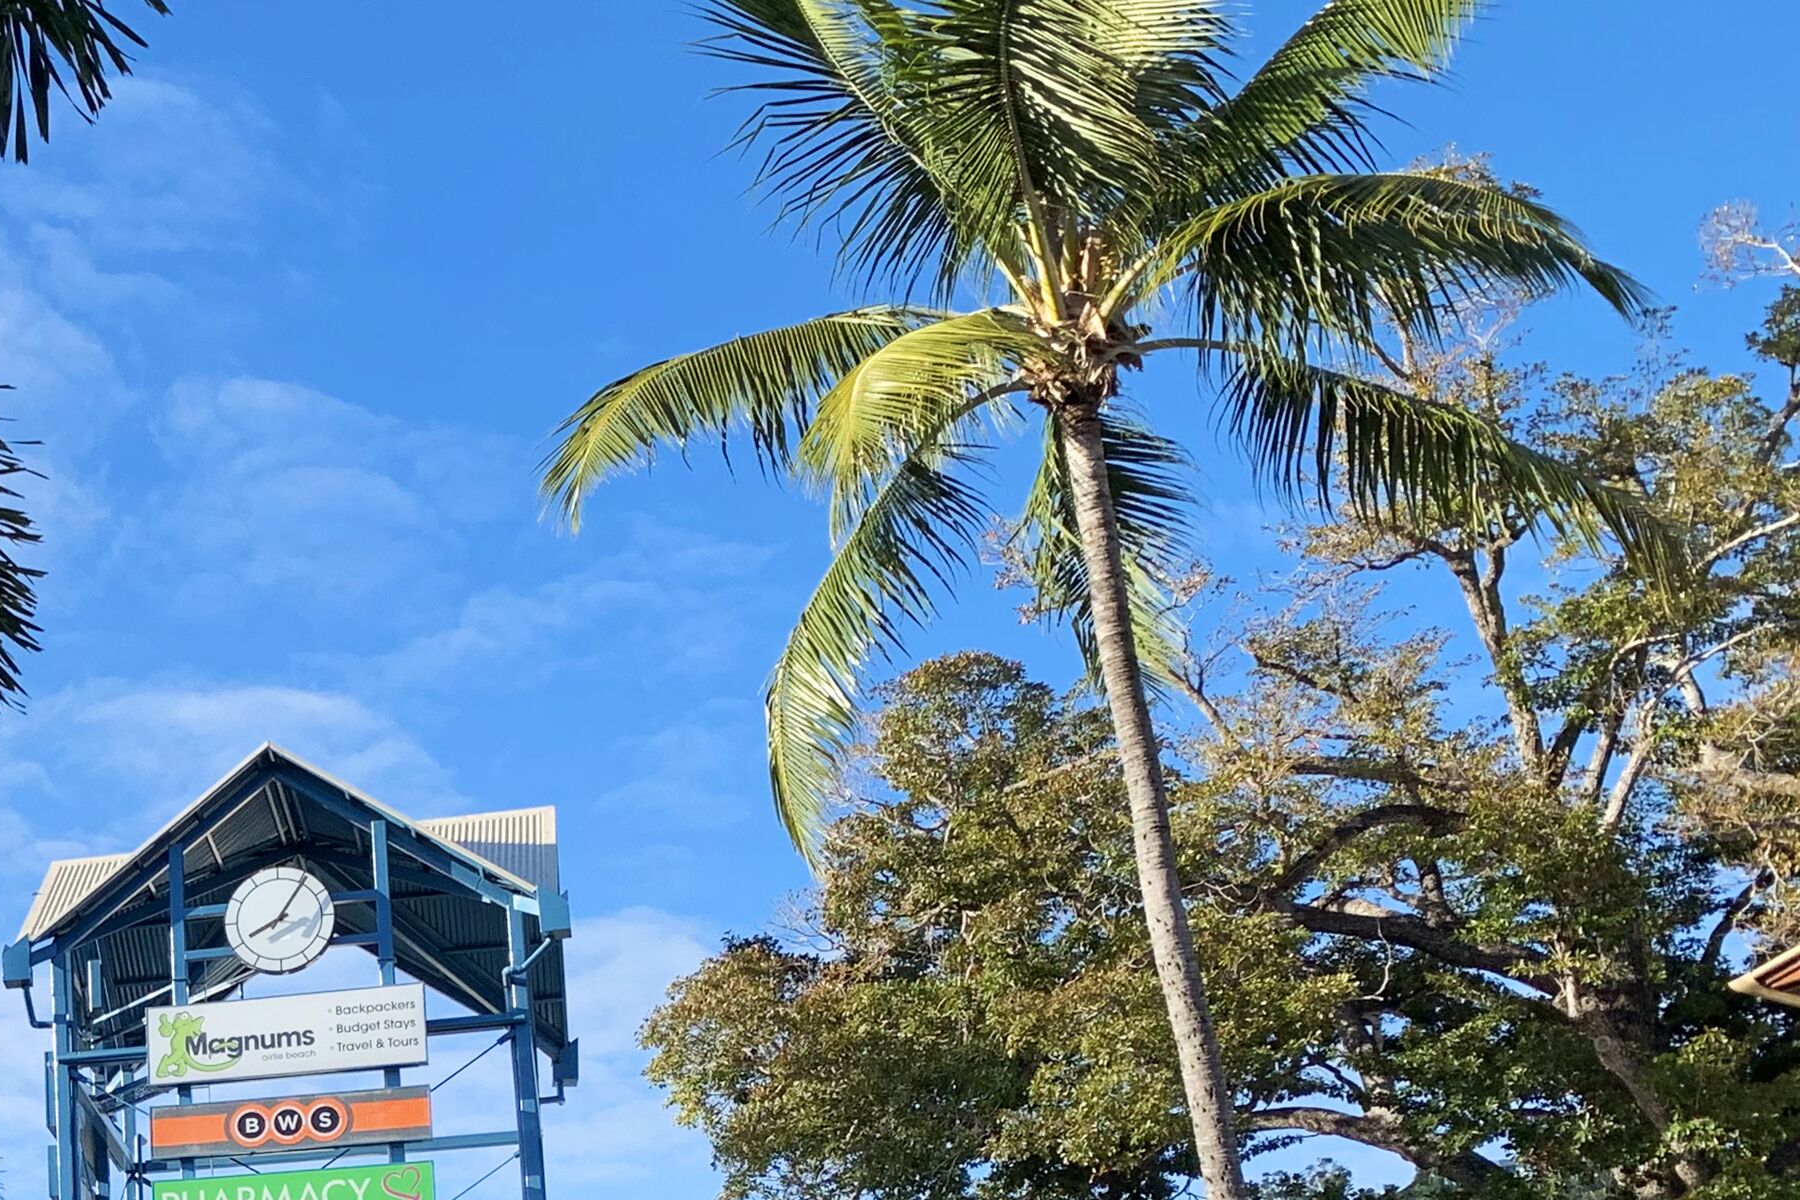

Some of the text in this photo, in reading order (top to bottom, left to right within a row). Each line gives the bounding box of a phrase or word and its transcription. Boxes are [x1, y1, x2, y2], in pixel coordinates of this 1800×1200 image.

[335, 999, 416, 1016] Backpackers
[336, 1018, 416, 1036] Budget Stays
[184, 1027, 316, 1060] Magnums
[336, 1035, 419, 1053] Travel & Tours
[261, 1049, 317, 1062] airlie beach
[245, 1112, 332, 1134] BWS
